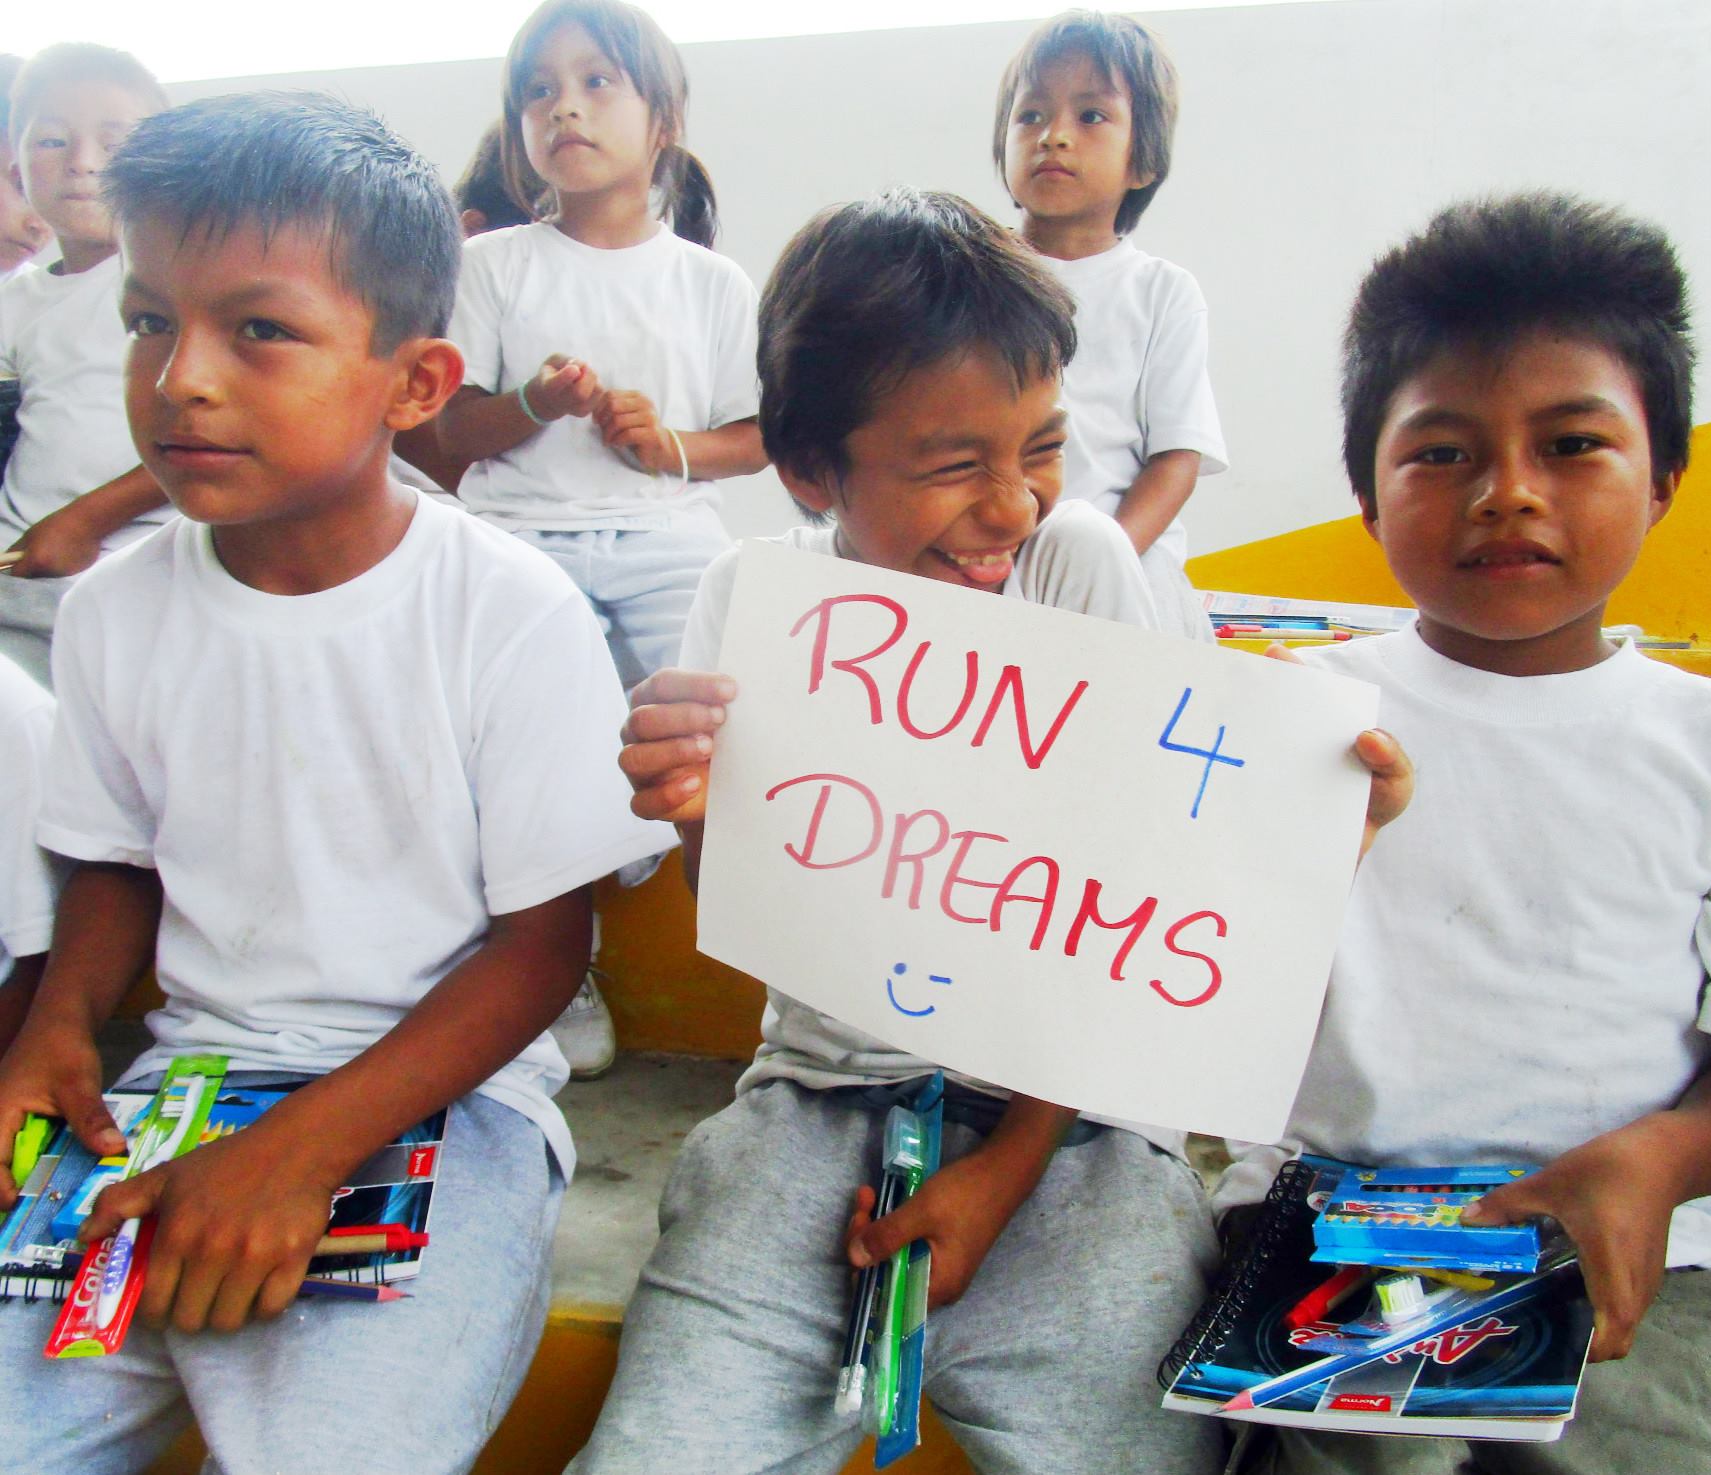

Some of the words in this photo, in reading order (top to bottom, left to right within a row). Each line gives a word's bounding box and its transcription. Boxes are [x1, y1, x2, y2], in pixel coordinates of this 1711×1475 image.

[789, 594, 1088, 769] RUN
[1158, 688, 1244, 818] 4
[766, 774, 1227, 1007] DREAMS
[1340, 1396, 1385, 1408] Norma
